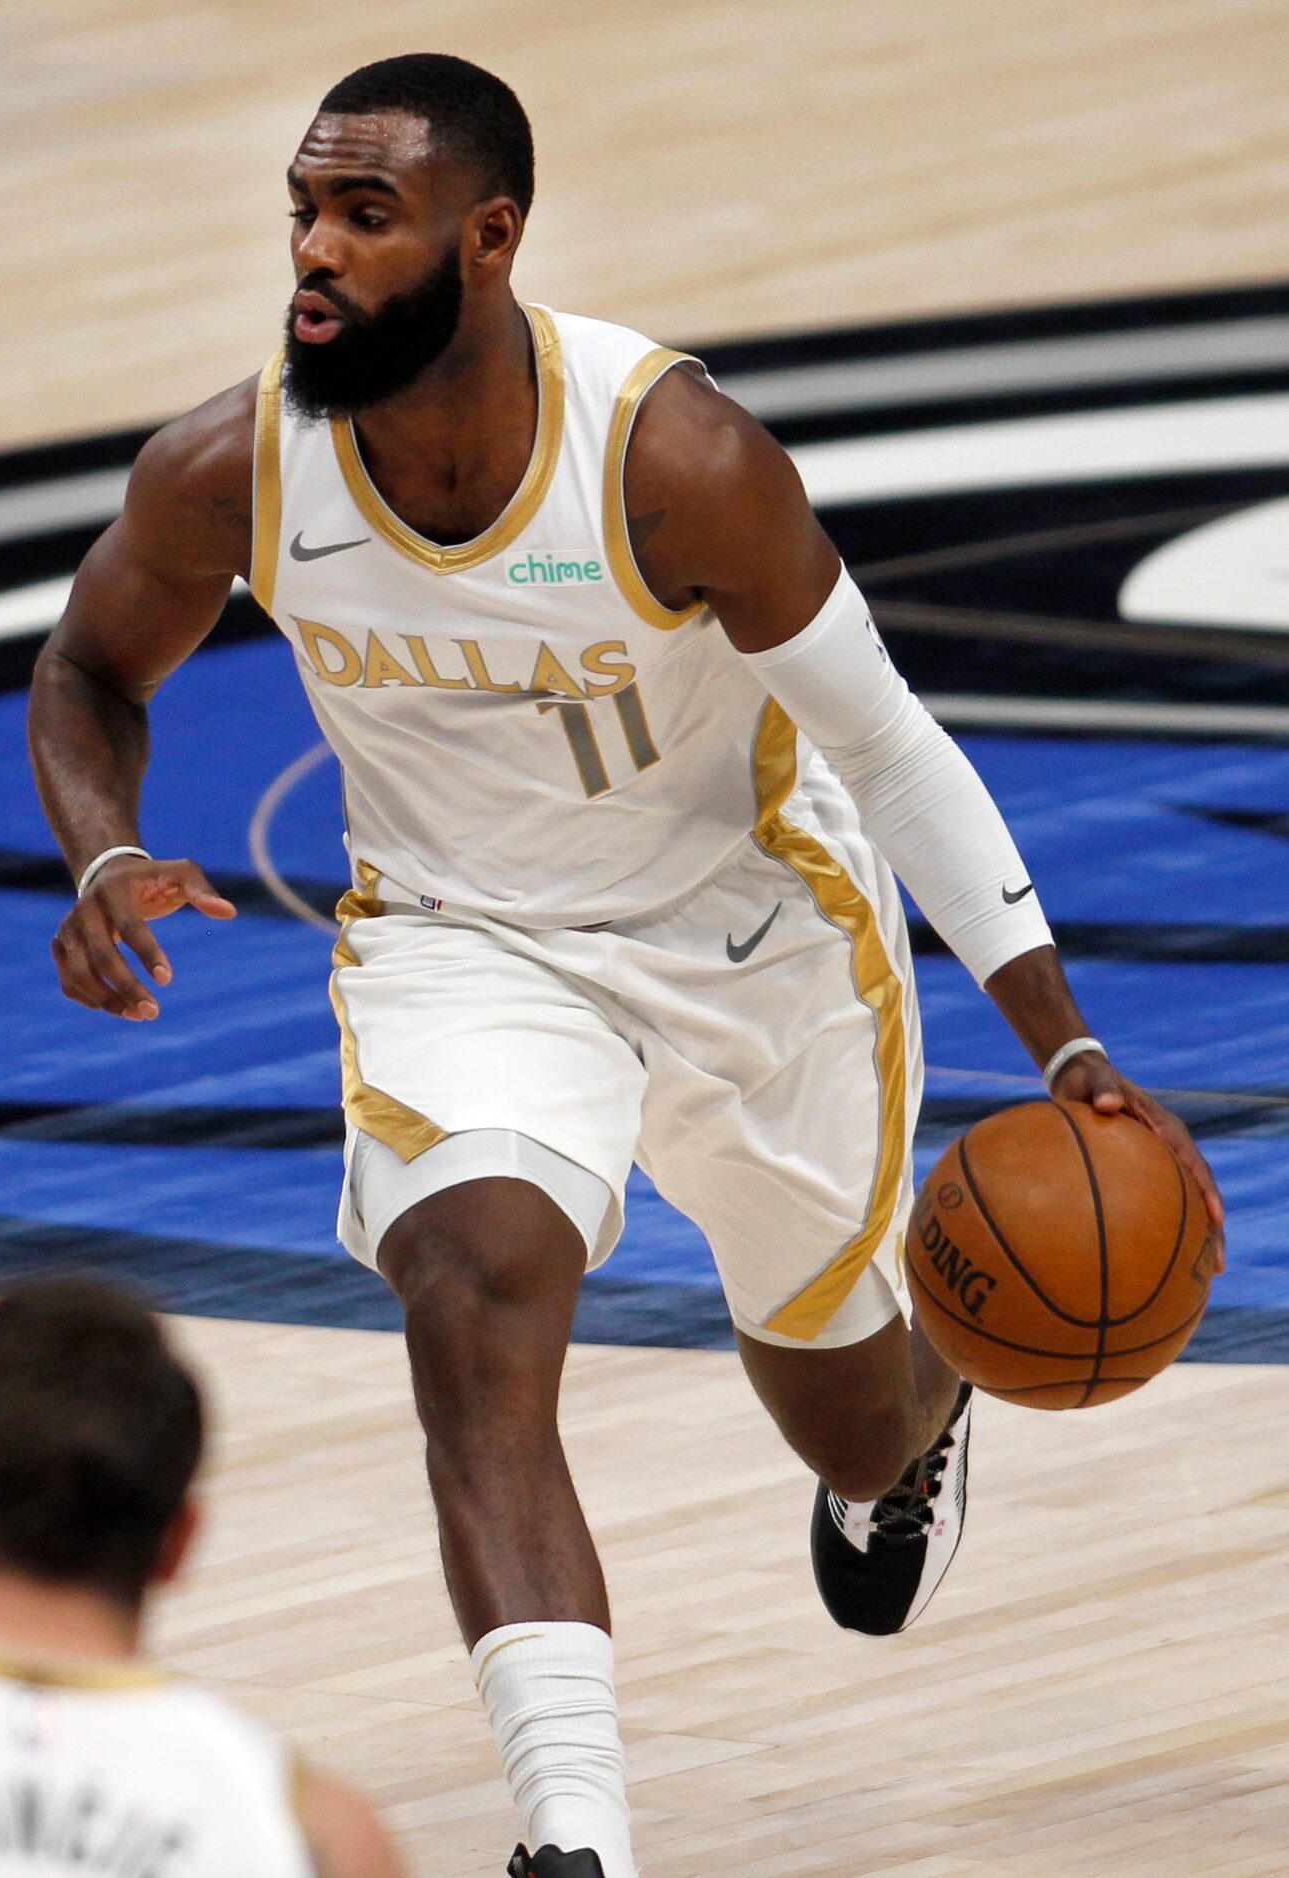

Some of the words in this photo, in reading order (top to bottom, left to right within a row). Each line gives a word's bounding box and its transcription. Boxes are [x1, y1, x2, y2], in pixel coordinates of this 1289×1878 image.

[509, 554, 602, 583] chime
[288, 615, 636, 699] DALLAS
[536, 681, 661, 798] 11
